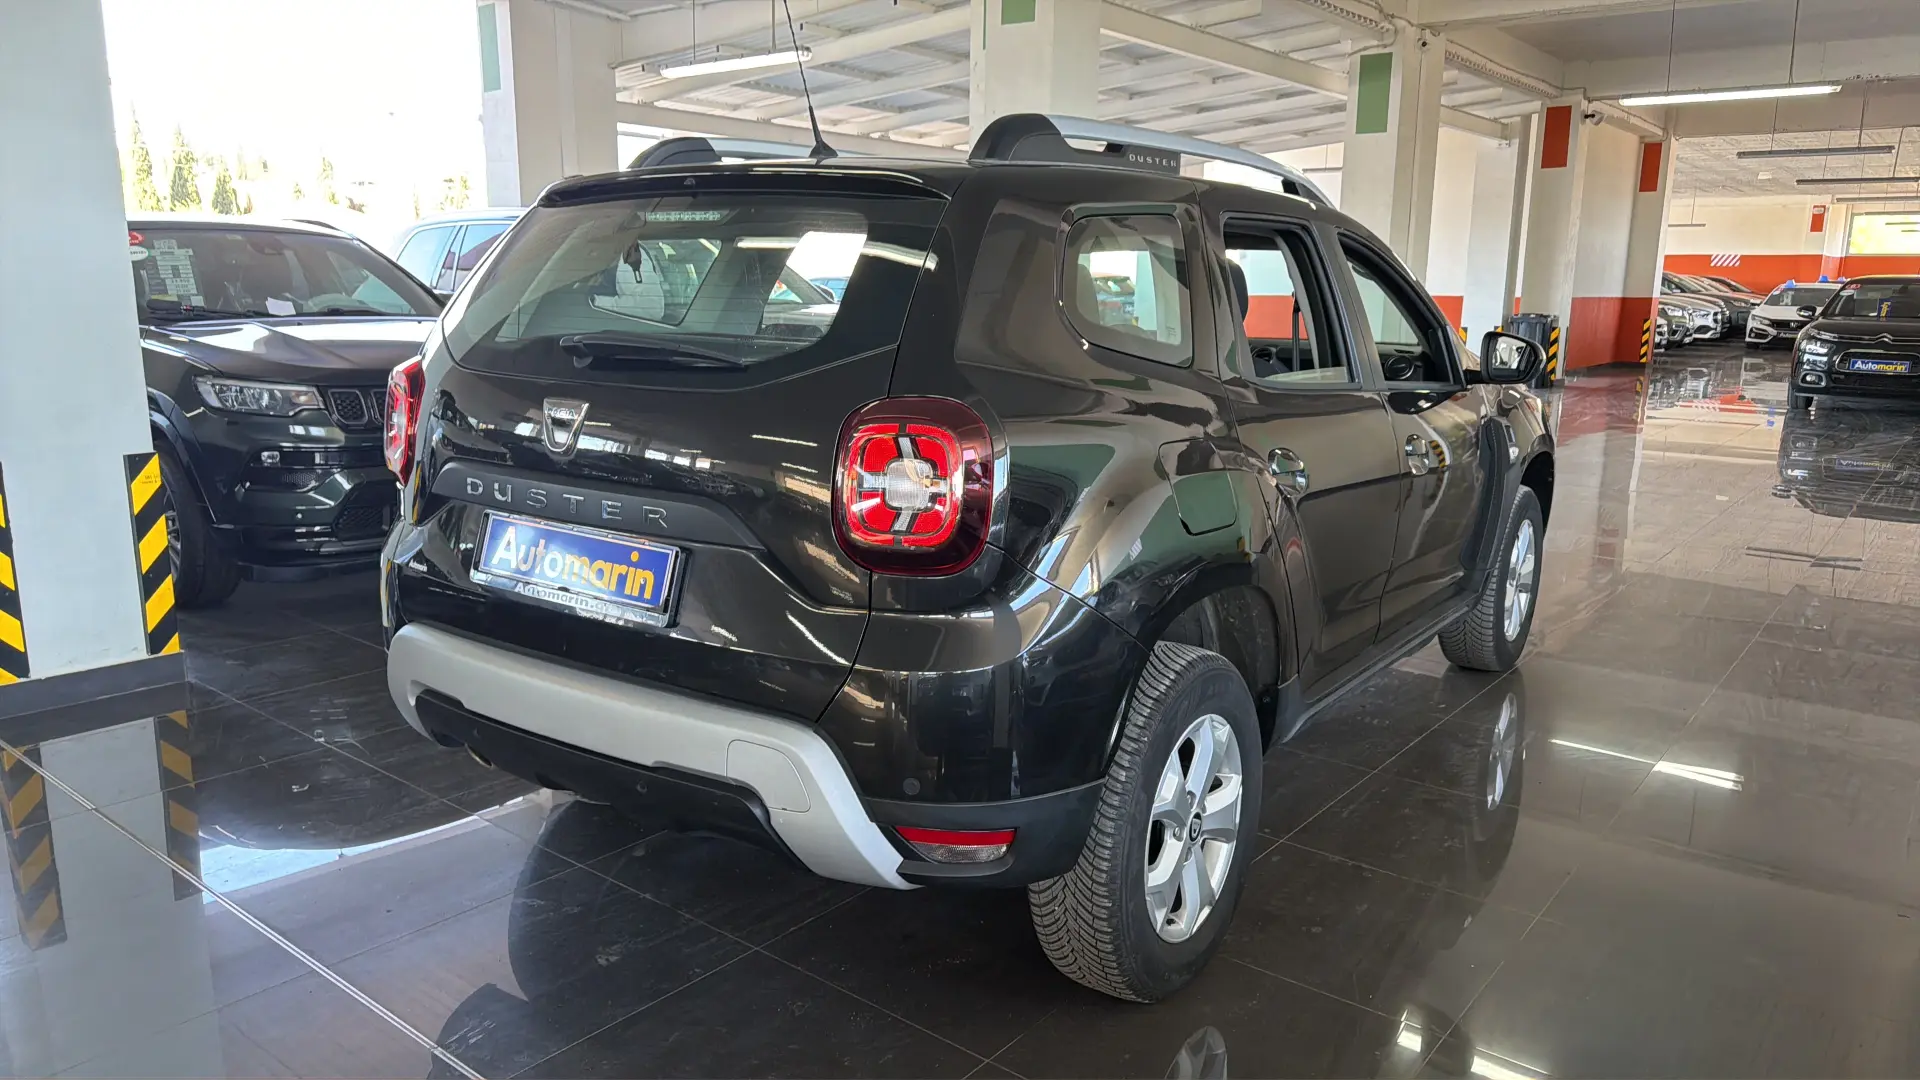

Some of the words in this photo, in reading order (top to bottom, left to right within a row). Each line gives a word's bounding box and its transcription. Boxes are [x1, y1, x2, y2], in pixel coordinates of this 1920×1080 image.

[1129, 153, 1177, 167] DUSTER
[1854, 360, 1905, 371] Automarin
[466, 477, 668, 529] DUSTER
[491, 525, 655, 600] Automarin
